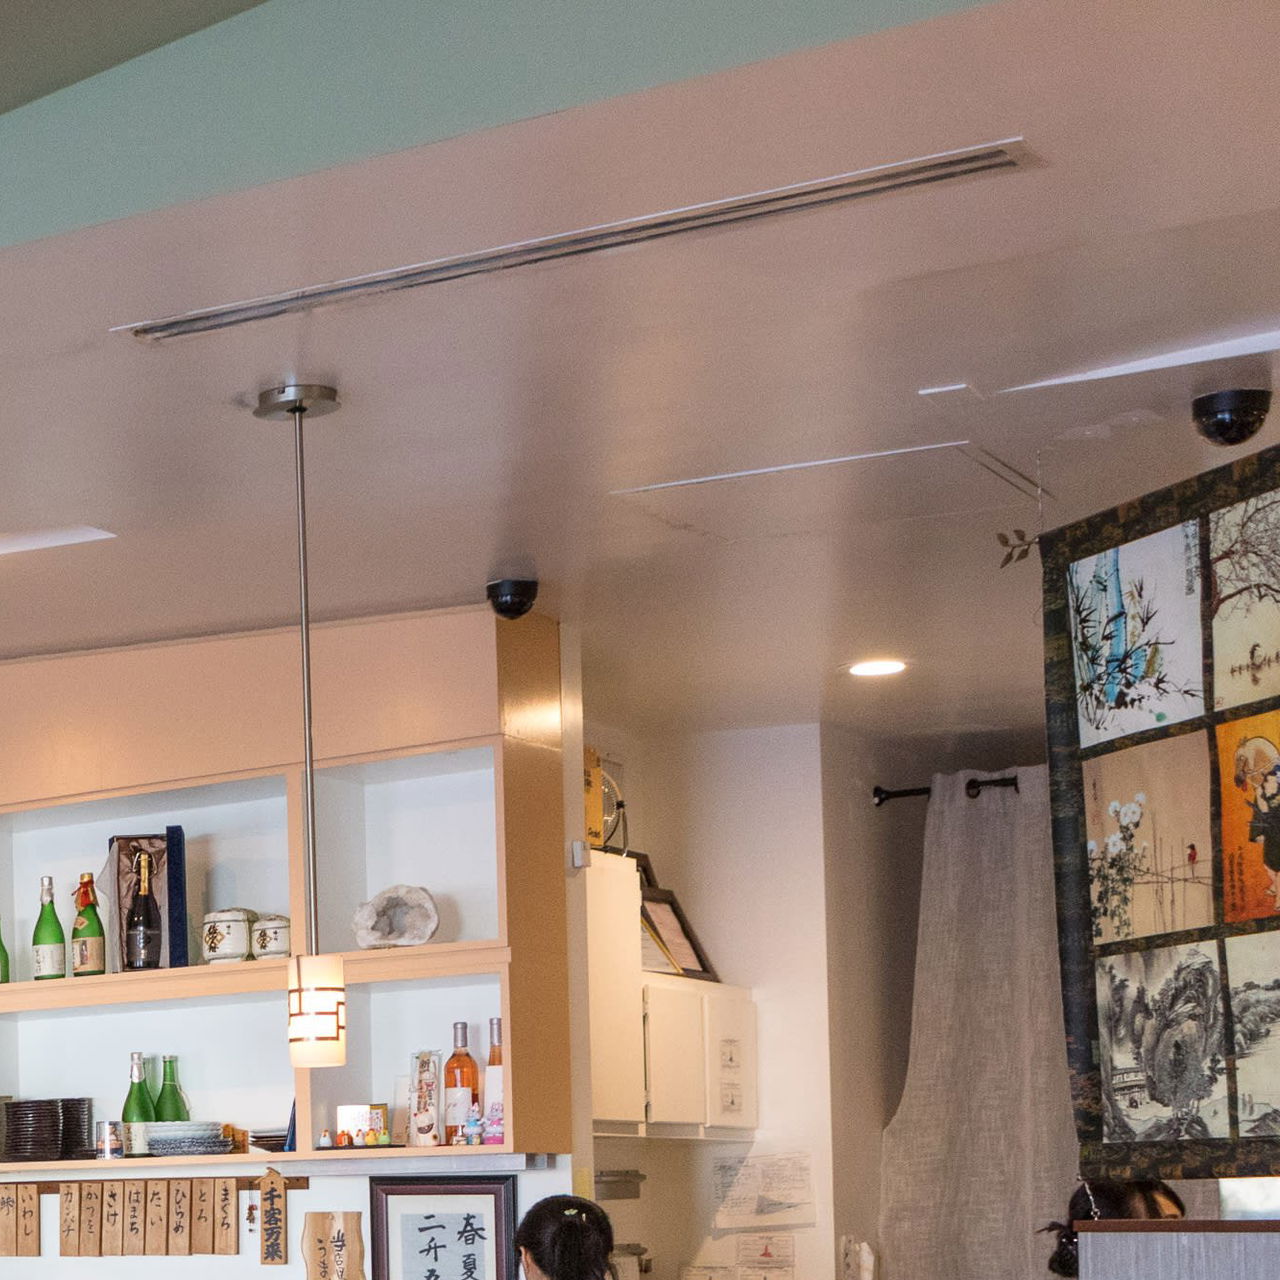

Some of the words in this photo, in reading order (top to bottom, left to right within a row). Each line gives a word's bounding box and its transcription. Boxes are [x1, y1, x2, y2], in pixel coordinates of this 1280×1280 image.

[21, 1194, 34, 1237] いわし
[106, 1190, 119, 1226] さけ
[128, 1189, 141, 1235] はまち
[149, 1189, 163, 1226] たい
[173, 1188, 187, 1234] ひらめ
[196, 1189, 208, 1223] とろ
[220, 1187, 231, 1231] まぐろ
[262, 1187, 282, 1261] 千客万来
